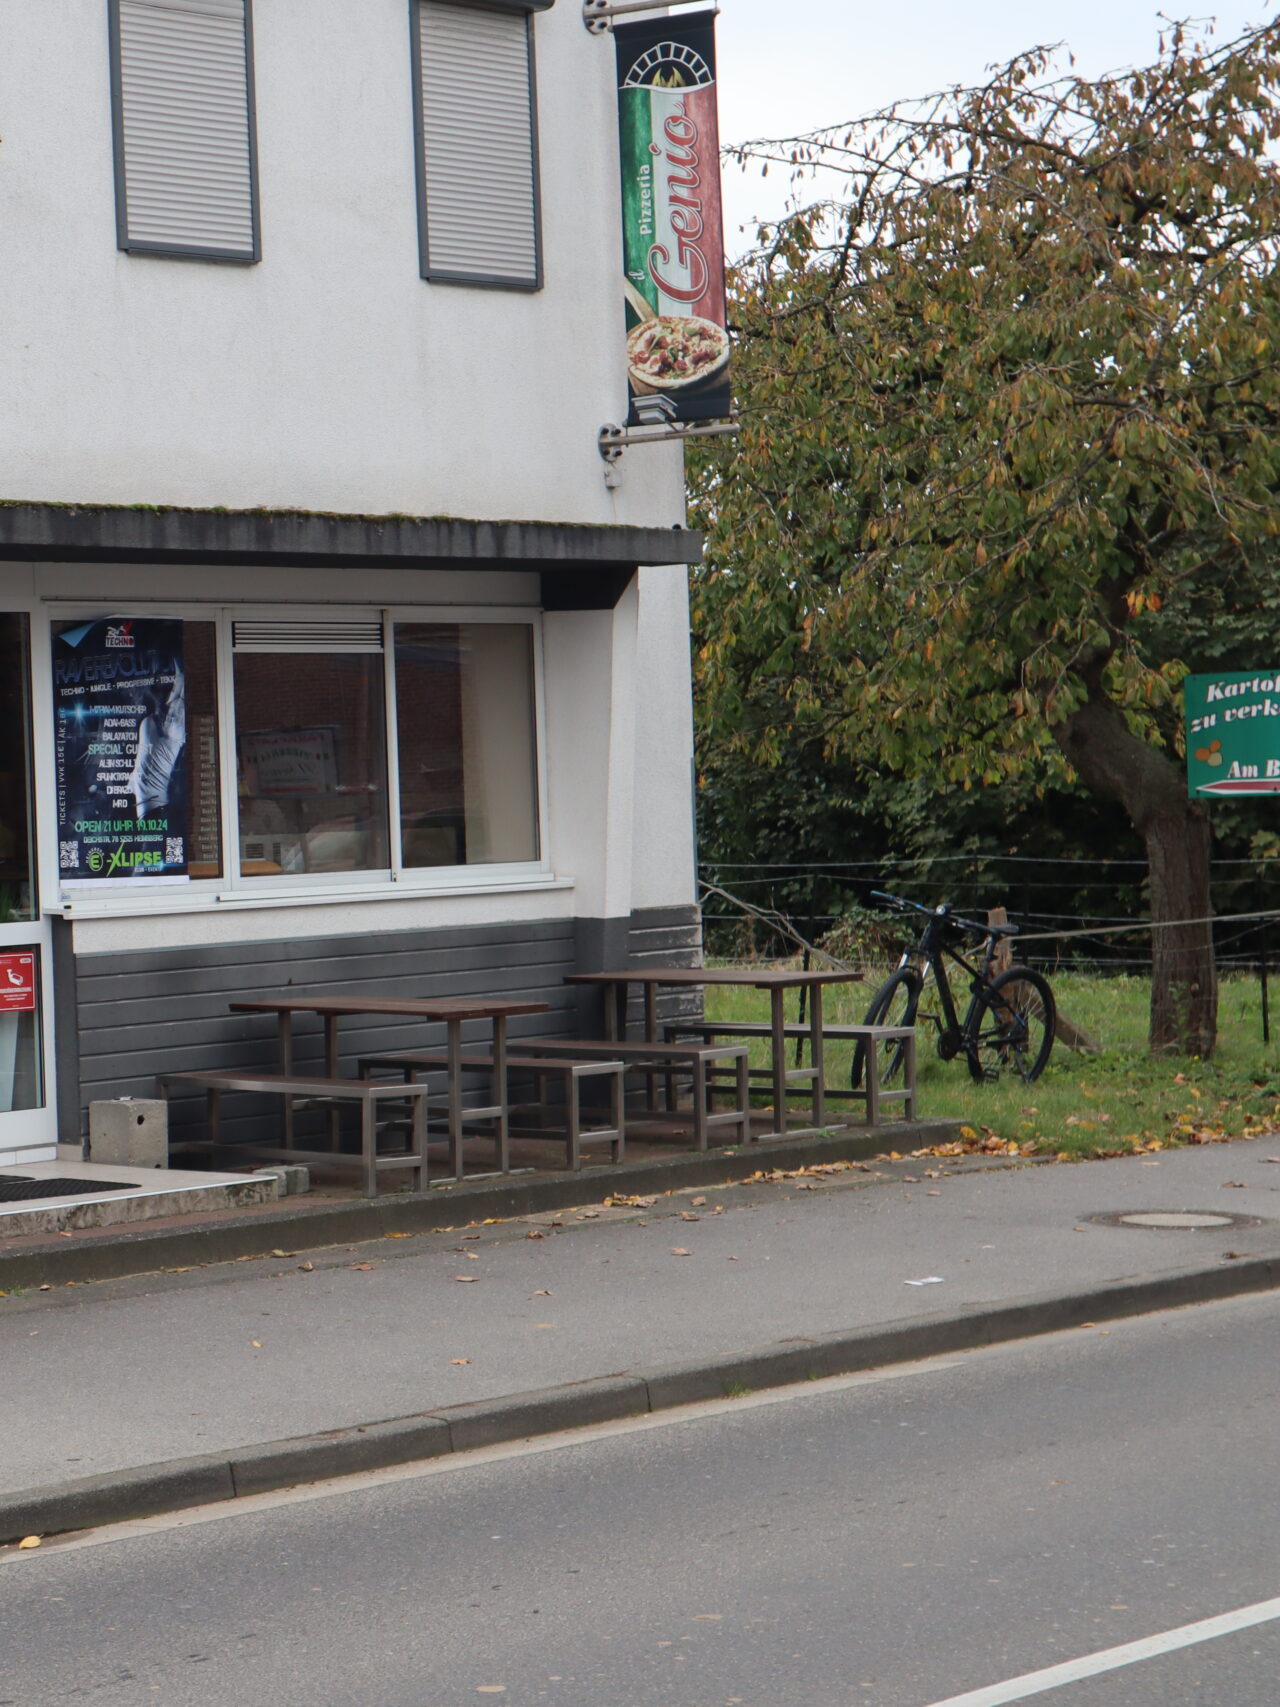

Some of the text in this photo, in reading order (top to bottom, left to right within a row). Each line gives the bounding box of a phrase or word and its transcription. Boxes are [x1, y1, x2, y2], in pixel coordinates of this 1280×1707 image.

[639, 163, 652, 236] Pizzeria
[647, 100, 709, 304] Genio
[1190, 713, 1217, 734] zu
[88, 743, 123, 755] SPECIAL
[1227, 760, 1258, 778] Am
[59, 790, 67, 826] TICKETS
[75, 820, 102, 833] OPEN
[103, 820, 112, 832] 21
[113, 819, 134, 832] UHR
